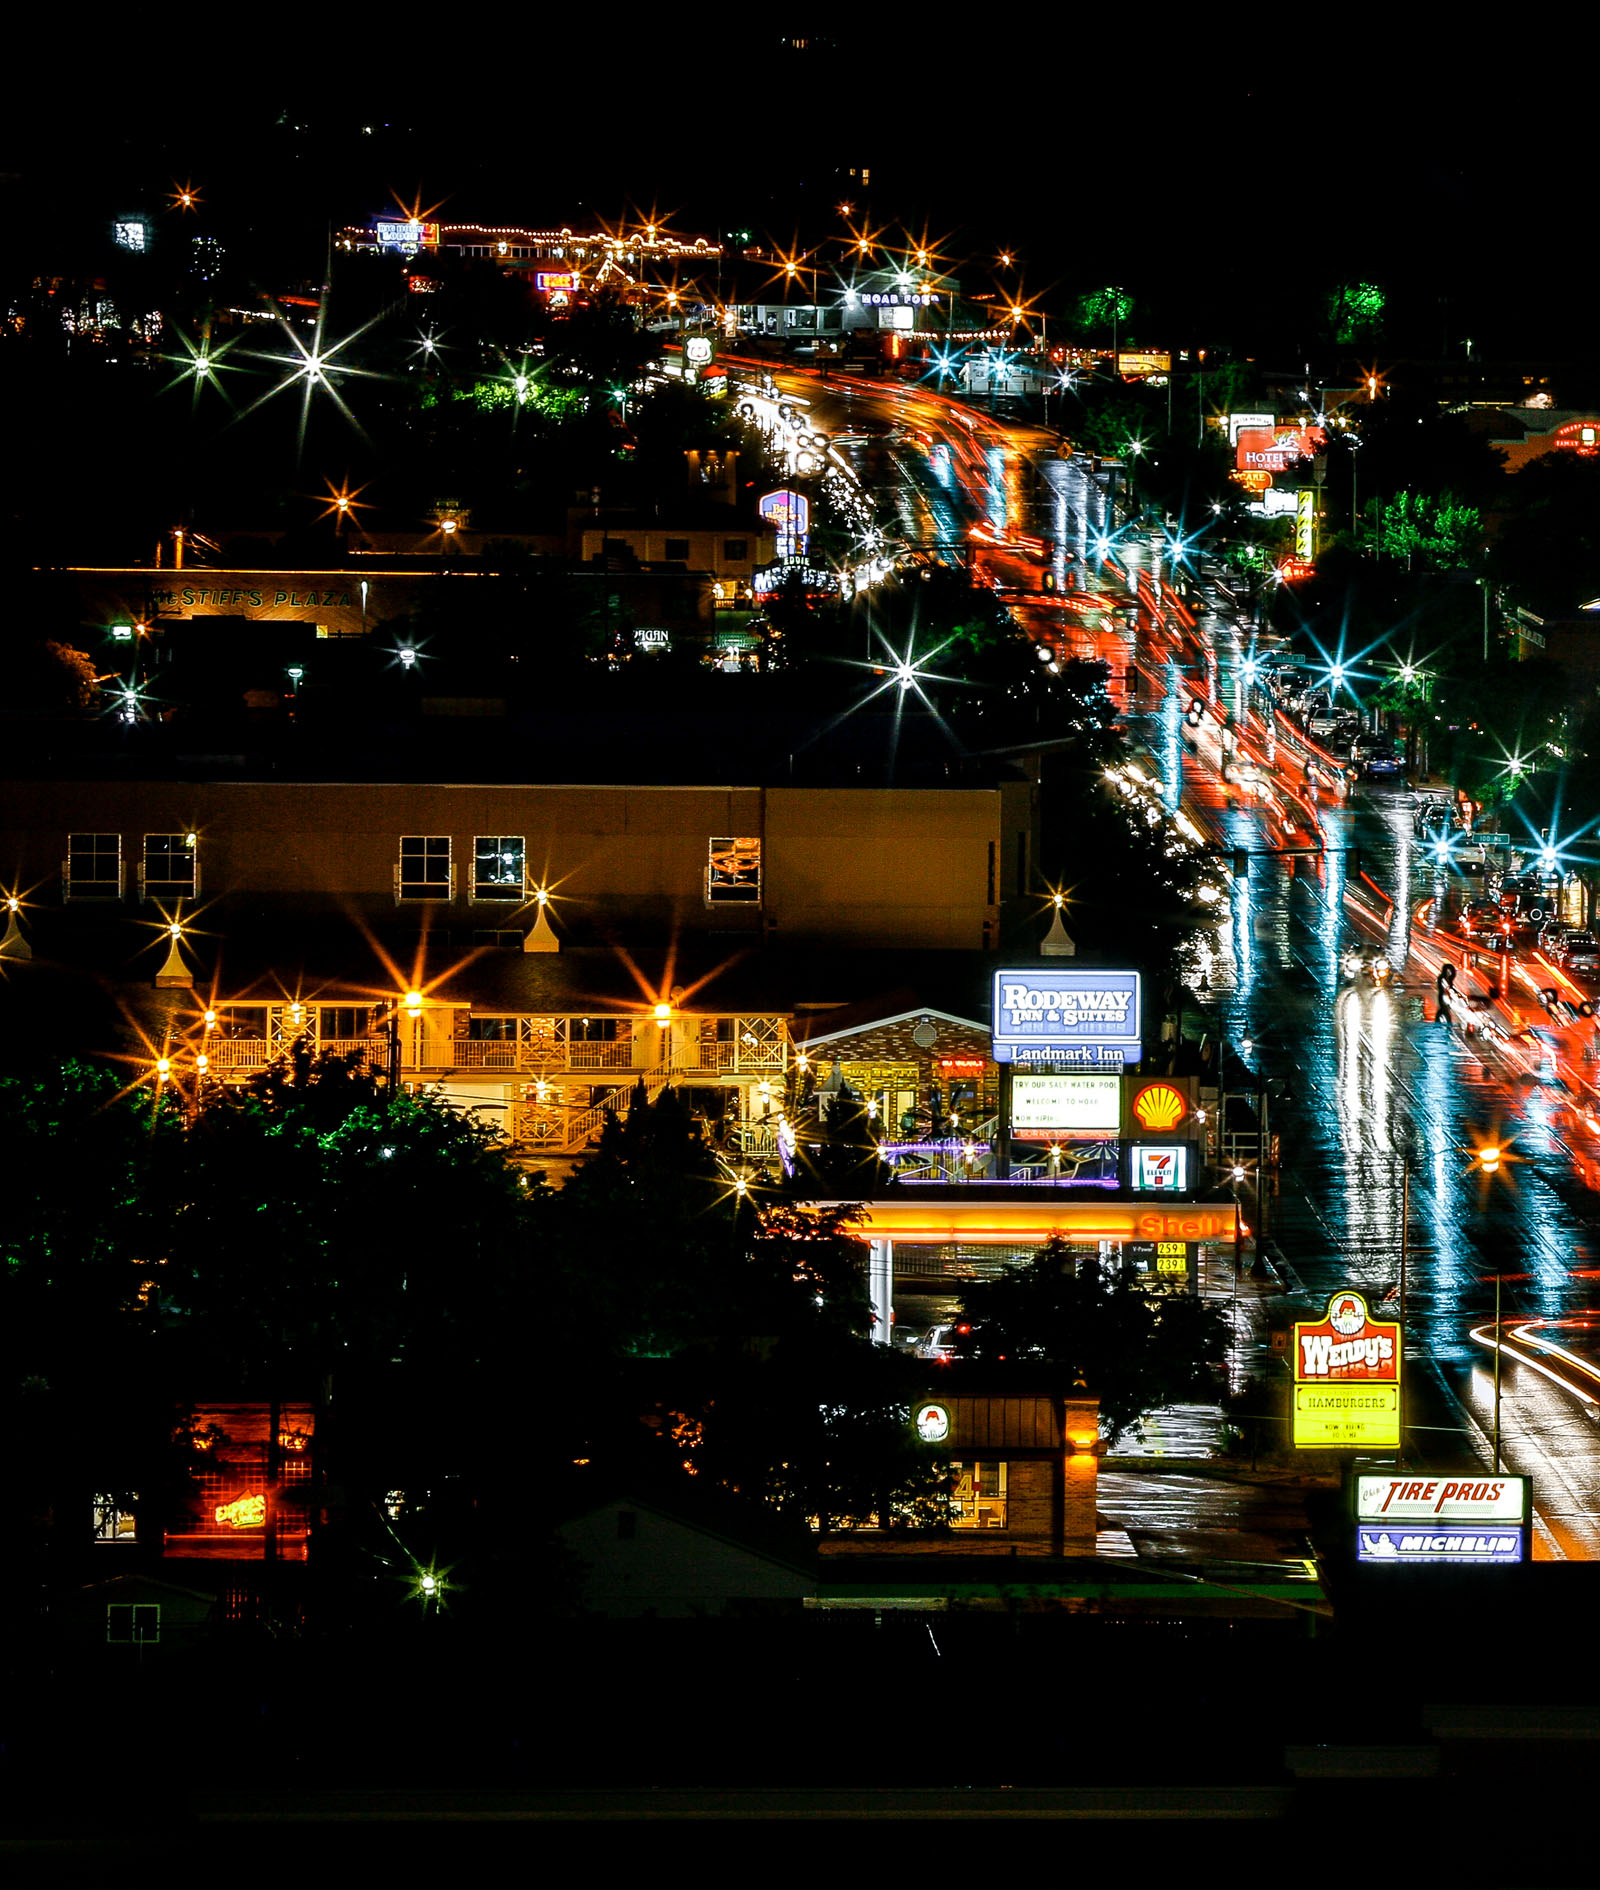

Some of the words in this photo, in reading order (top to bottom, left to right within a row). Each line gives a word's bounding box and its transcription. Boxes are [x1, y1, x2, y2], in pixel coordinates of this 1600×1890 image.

[861, 293, 899, 305] MOAB
[783, 556, 811, 566] EDDIE
[273, 590, 353, 607] PLAZA
[1002, 983, 1133, 1010] RODEWAY
[1010, 1009, 1043, 1026] INN
[1046, 1009, 1060, 1022] &
[1063, 1009, 1126, 1026] SUITES
[1010, 1045, 1093, 1061] Landmark
[1096, 1045, 1125, 1061] Inn
[1014, 1081, 1029, 1089] TRY
[1031, 1081, 1046, 1089] OUR
[1049, 1081, 1068, 1089] SALT
[1070, 1081, 1095, 1089] WATER
[1099, 1081, 1118, 1089] POOL
[1148, 1155, 1170, 1169] 7
[1141, 1215, 1220, 1237] Shell
[1308, 1397, 1386, 1409] HAMBURGERS
[1380, 1481, 1440, 1514] TIRE
[1433, 1482, 1506, 1514] PROS
[1399, 1535, 1519, 1552] MICHELIN
